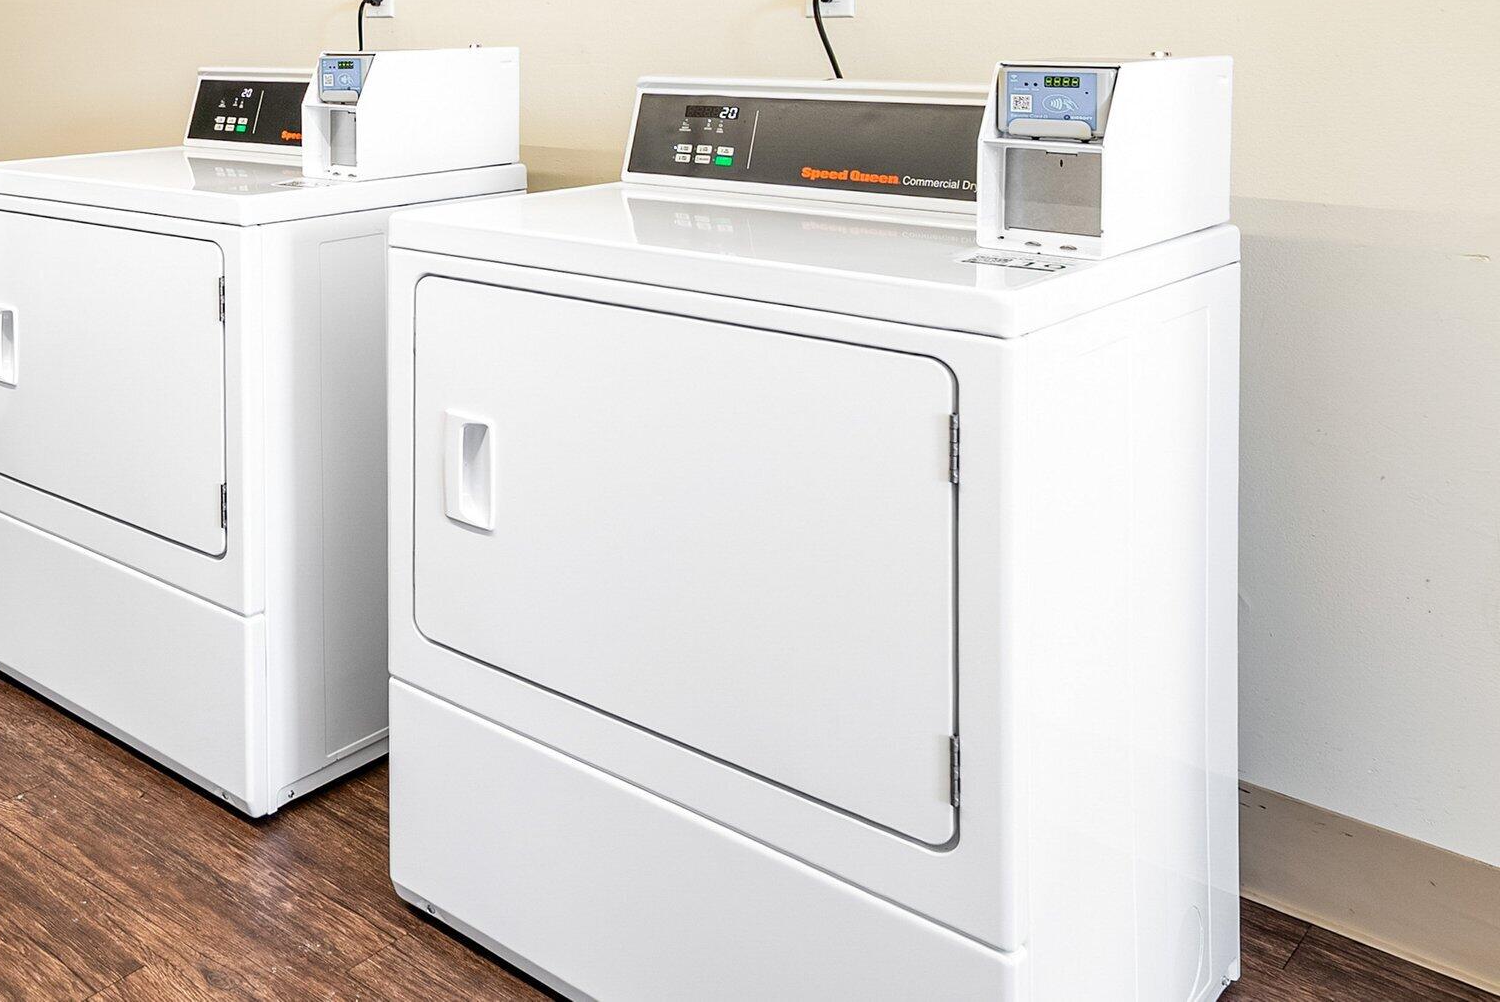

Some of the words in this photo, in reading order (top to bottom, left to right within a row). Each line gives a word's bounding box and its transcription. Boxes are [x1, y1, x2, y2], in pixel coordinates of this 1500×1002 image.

[241, 88, 253, 98] 20
[719, 106, 738, 119] 20
[801, 167, 849, 181] Speed
[850, 170, 899, 184] Queen
[902, 175, 960, 189] Commercial
